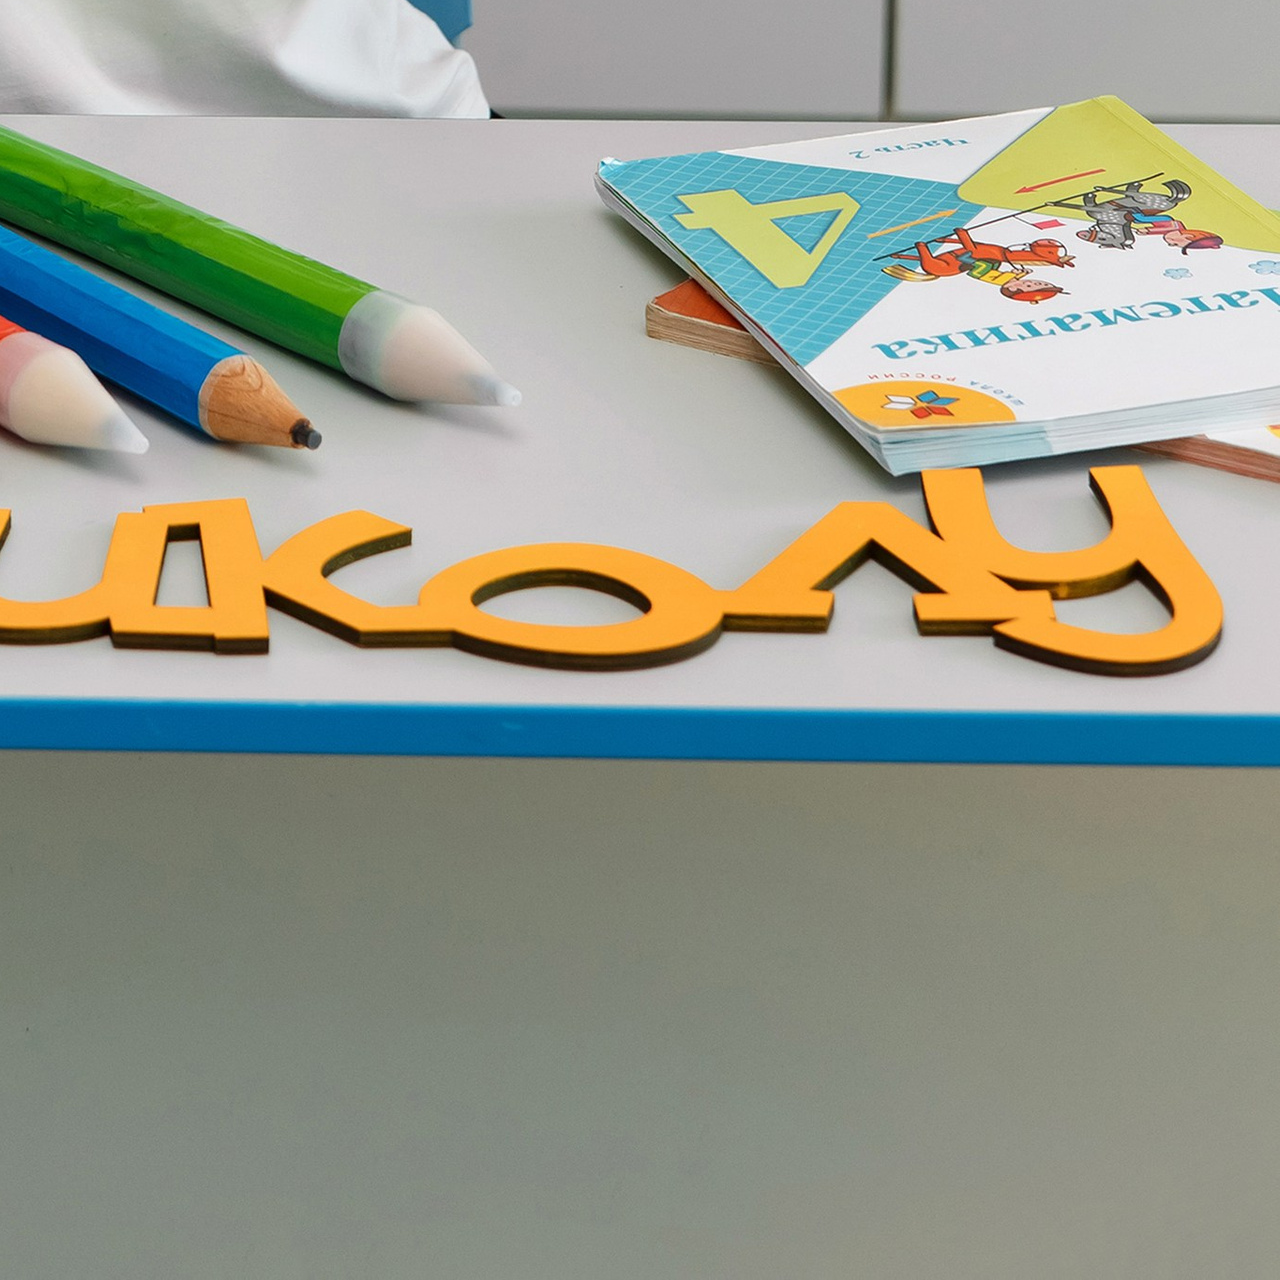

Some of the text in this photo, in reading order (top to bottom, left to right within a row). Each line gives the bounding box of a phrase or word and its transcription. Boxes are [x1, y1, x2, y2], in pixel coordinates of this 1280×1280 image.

[848, 137, 972, 160] Часть 2
[672, 188, 862, 289] 4
[866, 371, 958, 383] РОССИИ
